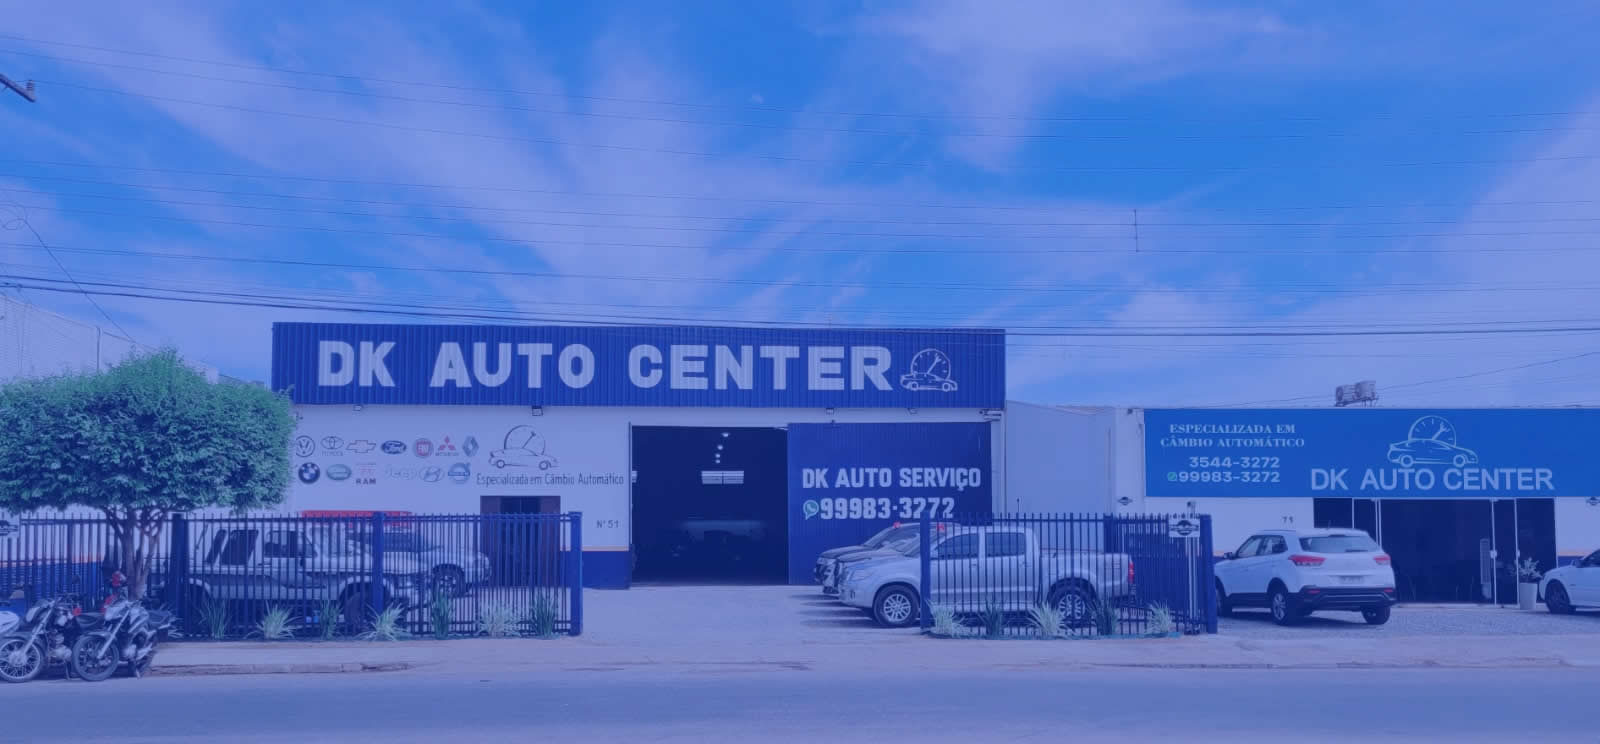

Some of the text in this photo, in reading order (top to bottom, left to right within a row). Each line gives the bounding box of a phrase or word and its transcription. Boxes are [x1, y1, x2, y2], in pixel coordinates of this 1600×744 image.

[317, 340, 893, 392] DK AUTO CENTER
[1169, 423, 1296, 434] ESPECIALIZADA EM
[1160, 434, 1305, 448] CÂMBIO AUTOMÁTICO
[1189, 456, 1281, 469] 3544-3272
[476, 472, 529, 487] Especializada
[529, 476, 542, 486] em
[545, 472, 575, 486] Câmbio
[578, 472, 624, 486] Automático
[802, 467, 981, 492] DK AUTO SERVIÇO
[1178, 471, 1281, 483] 99983-3272
[1311, 468, 1555, 491] DK AUTO CENTER
